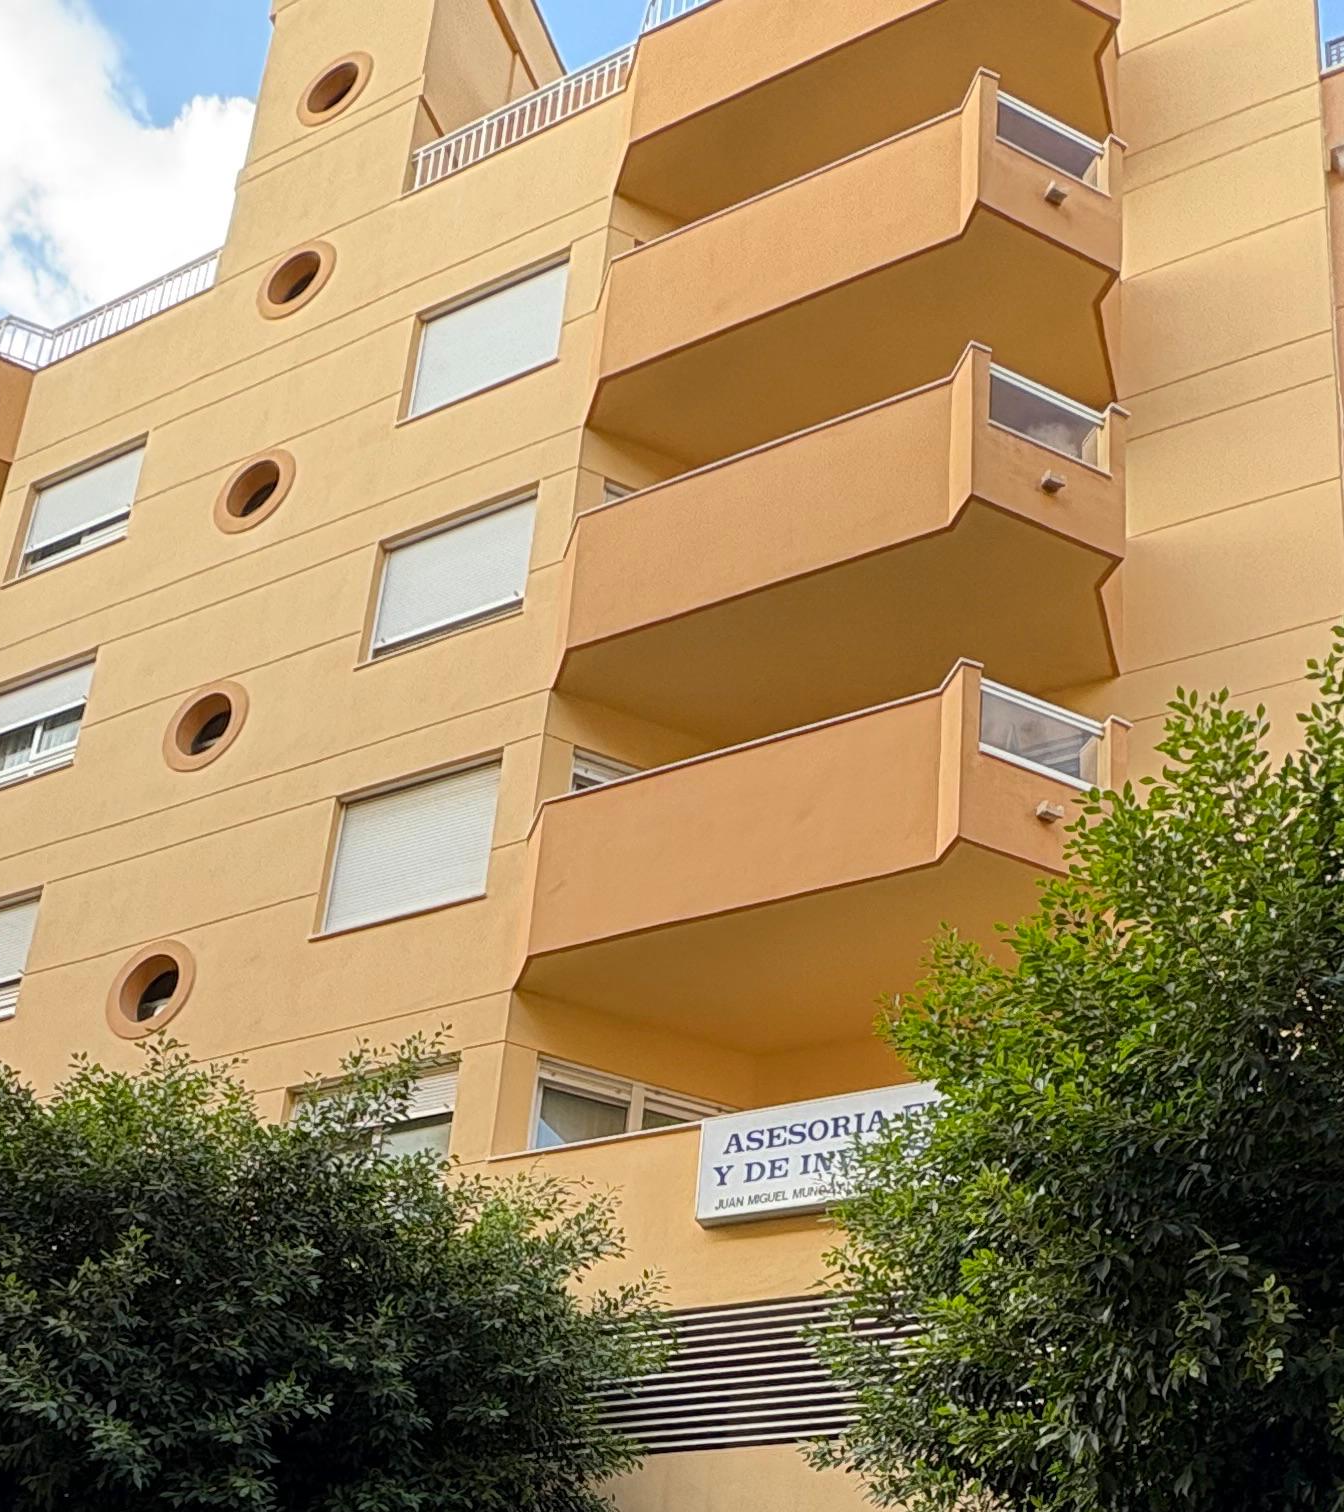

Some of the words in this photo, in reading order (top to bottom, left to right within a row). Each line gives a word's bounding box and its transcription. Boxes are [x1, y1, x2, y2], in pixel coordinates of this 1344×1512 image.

[723, 1110, 886, 1155] ASESORIA
[713, 1165, 734, 1187] Y
[743, 1157, 789, 1183] DE
[714, 1195, 744, 1211] JUAN
[747, 1190, 788, 1206] MIGUEL
